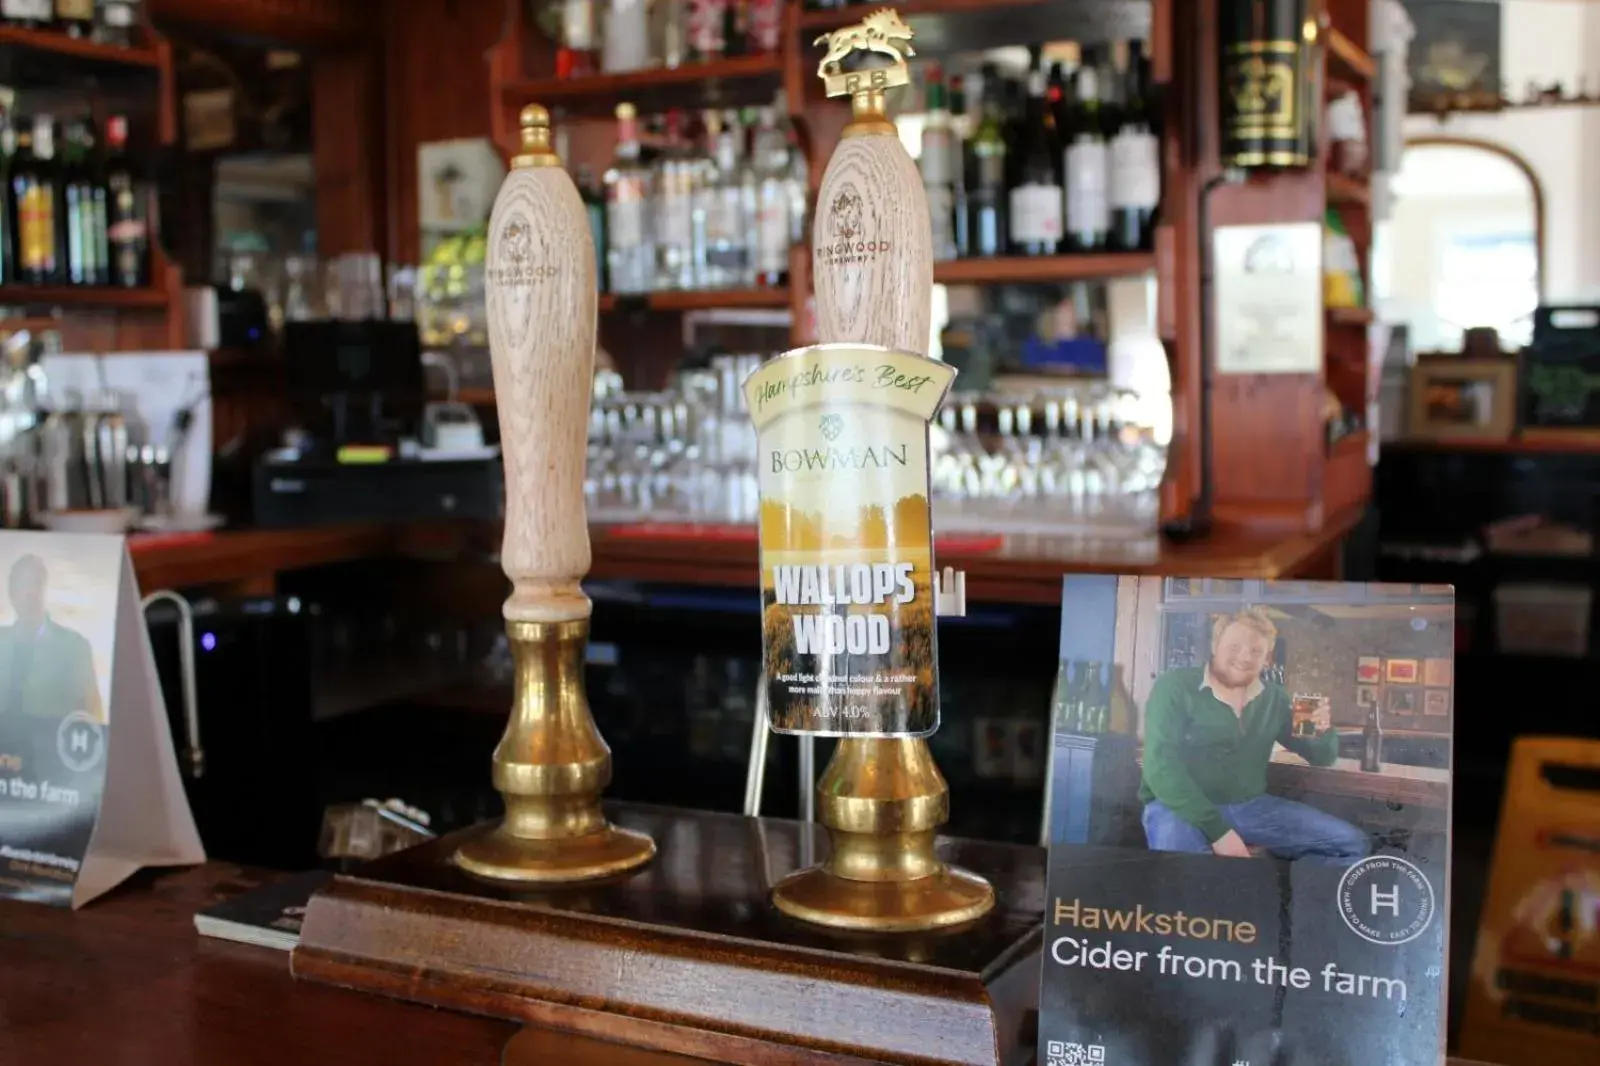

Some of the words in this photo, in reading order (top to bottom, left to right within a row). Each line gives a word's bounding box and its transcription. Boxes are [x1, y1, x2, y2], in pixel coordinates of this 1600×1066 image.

[872, 365, 936, 394] Best
[771, 444, 907, 474] BOWMAN
[774, 562, 915, 605] WALLOPS
[792, 613, 890, 655] WOOD
[782, 672, 798, 683] good
[799, 672, 814, 684] light
[815, 673, 848, 683] ctnut
[849, 673, 874, 684] colour
[876, 672, 882, 683] &
[890, 673, 917, 683] rather
[788, 686, 806, 695] more
[873, 686, 902, 696] flavour
[10, 777, 37, 800] the
[40, 780, 80, 806] farm
[1347, 866, 1366, 886] CIDER
[1366, 861, 1390, 870] FROM
[1371, 883, 1399, 917] H
[1054, 898, 1257, 943] Hawkstone
[1358, 922, 1381, 938] MAKE
[1389, 928, 1410, 939] EASY
[1051, 936, 1149, 972] Cider
[1157, 945, 1241, 982] from
[1252, 957, 1311, 990] the
[1320, 963, 1407, 1001] farm
